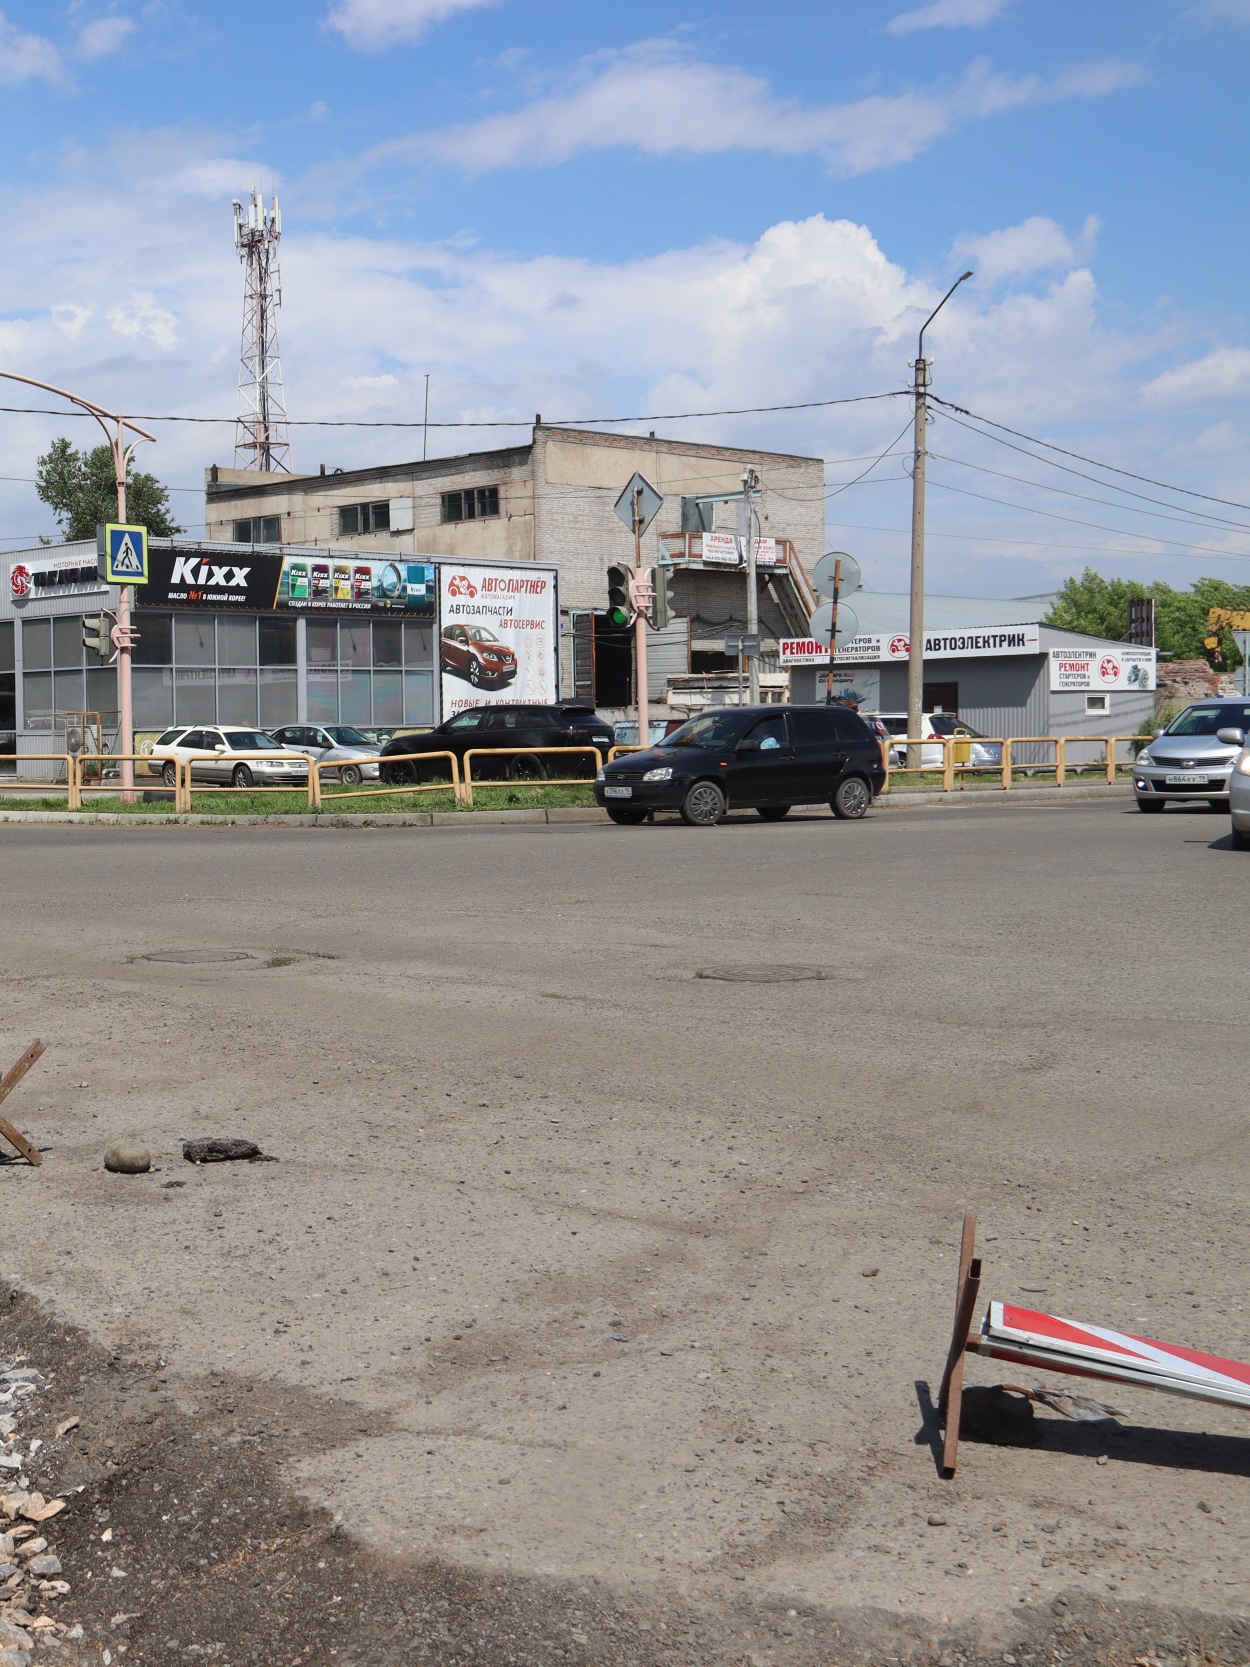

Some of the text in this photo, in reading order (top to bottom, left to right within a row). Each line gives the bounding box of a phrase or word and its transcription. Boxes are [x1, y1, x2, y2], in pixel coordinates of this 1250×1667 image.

[710, 536, 732, 544] АРЕНДА
[54, 557, 98, 569] МОТОРНЫЕ МАСЛ
[170, 556, 252, 587] Kixx
[481, 576, 546, 594] АВТОПАРТНЁР
[168, 592, 188, 600] МАСЛО
[207, 593, 228, 601] ЮЖНОЙ
[448, 604, 514, 616] АВТОЗАПЧАСТИ
[498, 618, 546, 630] АВТОСЕРВИС
[924, 632, 1026, 652] АВТОЭЛЕКТРИК
[834, 644, 880, 654] ГЕНЕРАТОРОВ
[1052, 650, 1097, 659] АВТОЭЛЕКТРИК
[1058, 662, 1090, 672] РЕМОНТ
[450, 699, 480, 708] НОВЫЕ
